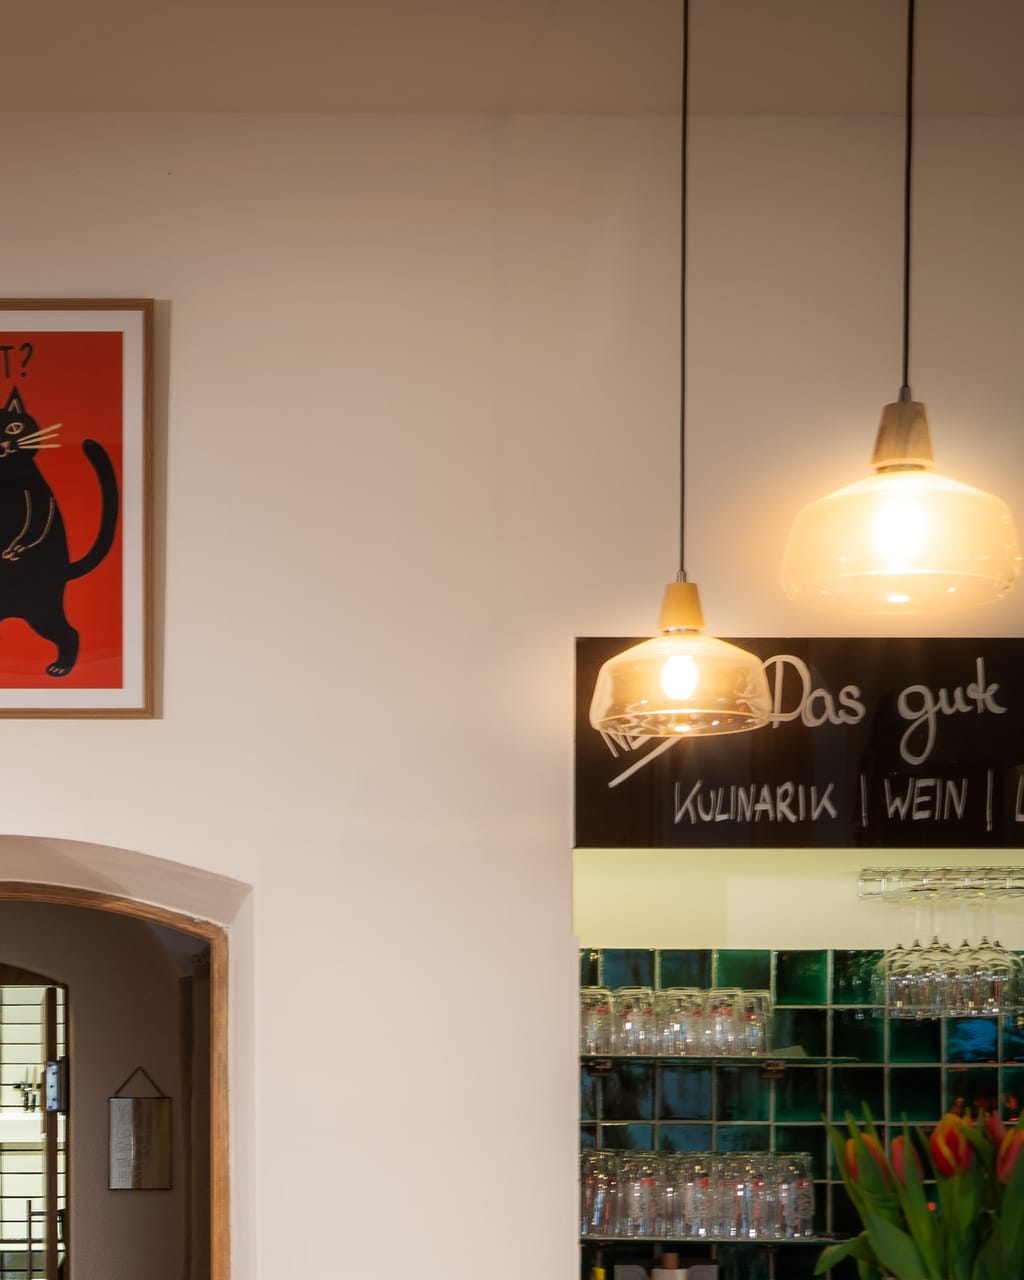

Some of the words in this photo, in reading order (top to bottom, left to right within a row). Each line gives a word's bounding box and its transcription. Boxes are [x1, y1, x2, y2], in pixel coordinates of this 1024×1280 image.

[760, 654, 866, 728] Das
[673, 779, 838, 824] KULINARIK
[884, 777, 969, 821] WEIN
